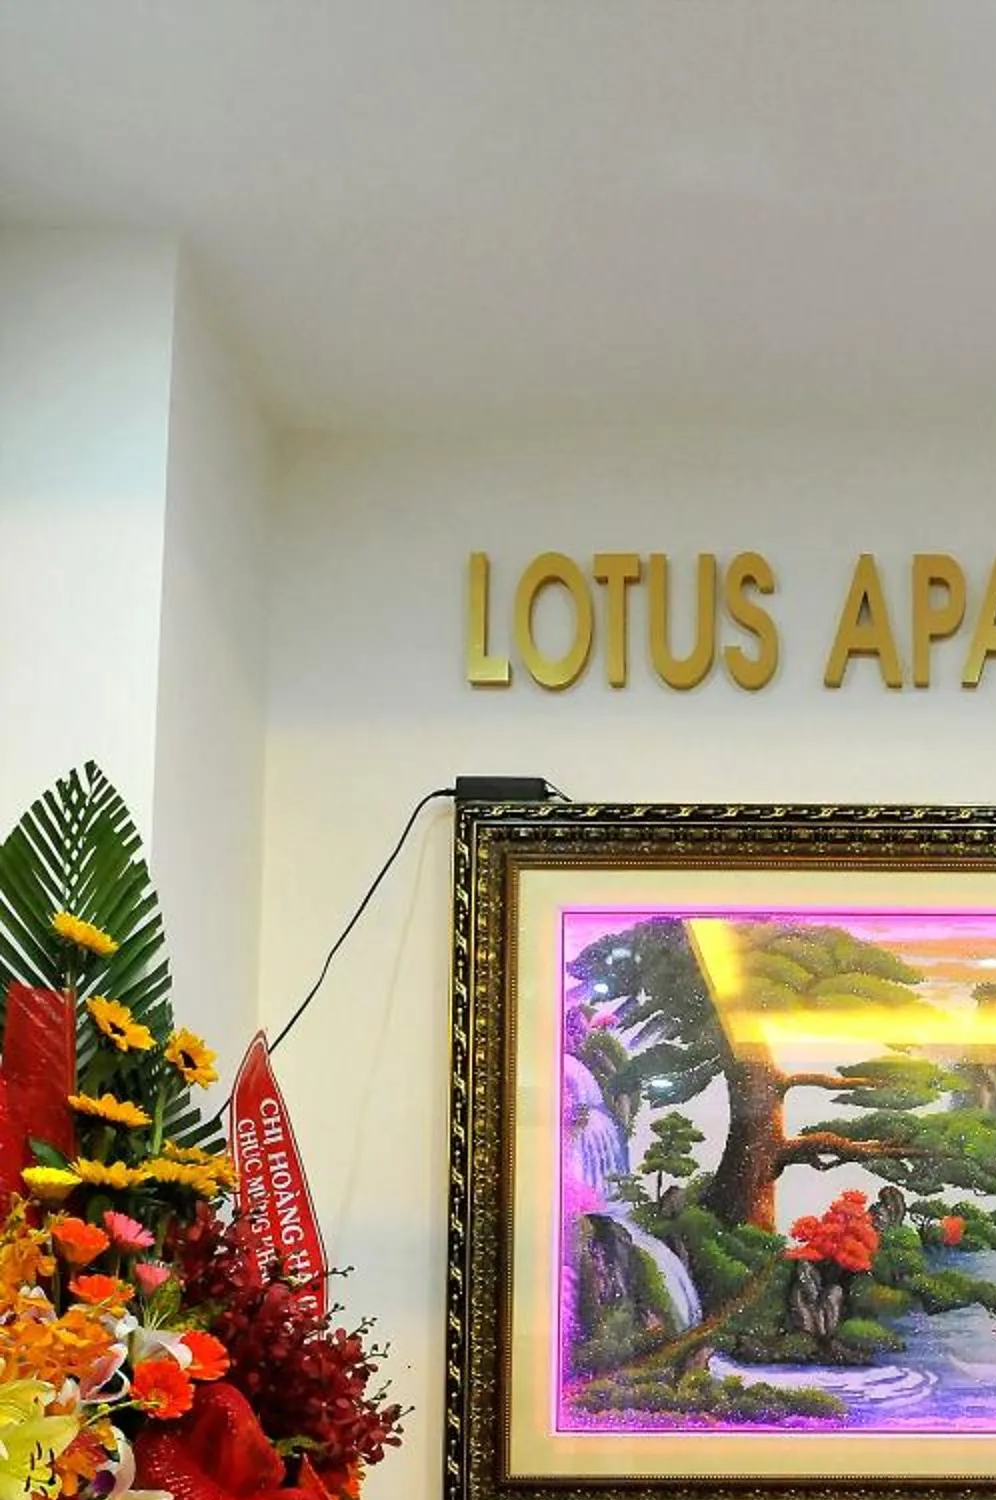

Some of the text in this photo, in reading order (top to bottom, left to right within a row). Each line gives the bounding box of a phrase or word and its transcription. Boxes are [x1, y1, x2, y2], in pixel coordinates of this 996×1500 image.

[467, 551, 779, 691] LOTUS
[238, 1119, 264, 1173] CHÚC
[267, 1151, 304, 1246] HOÀNG
